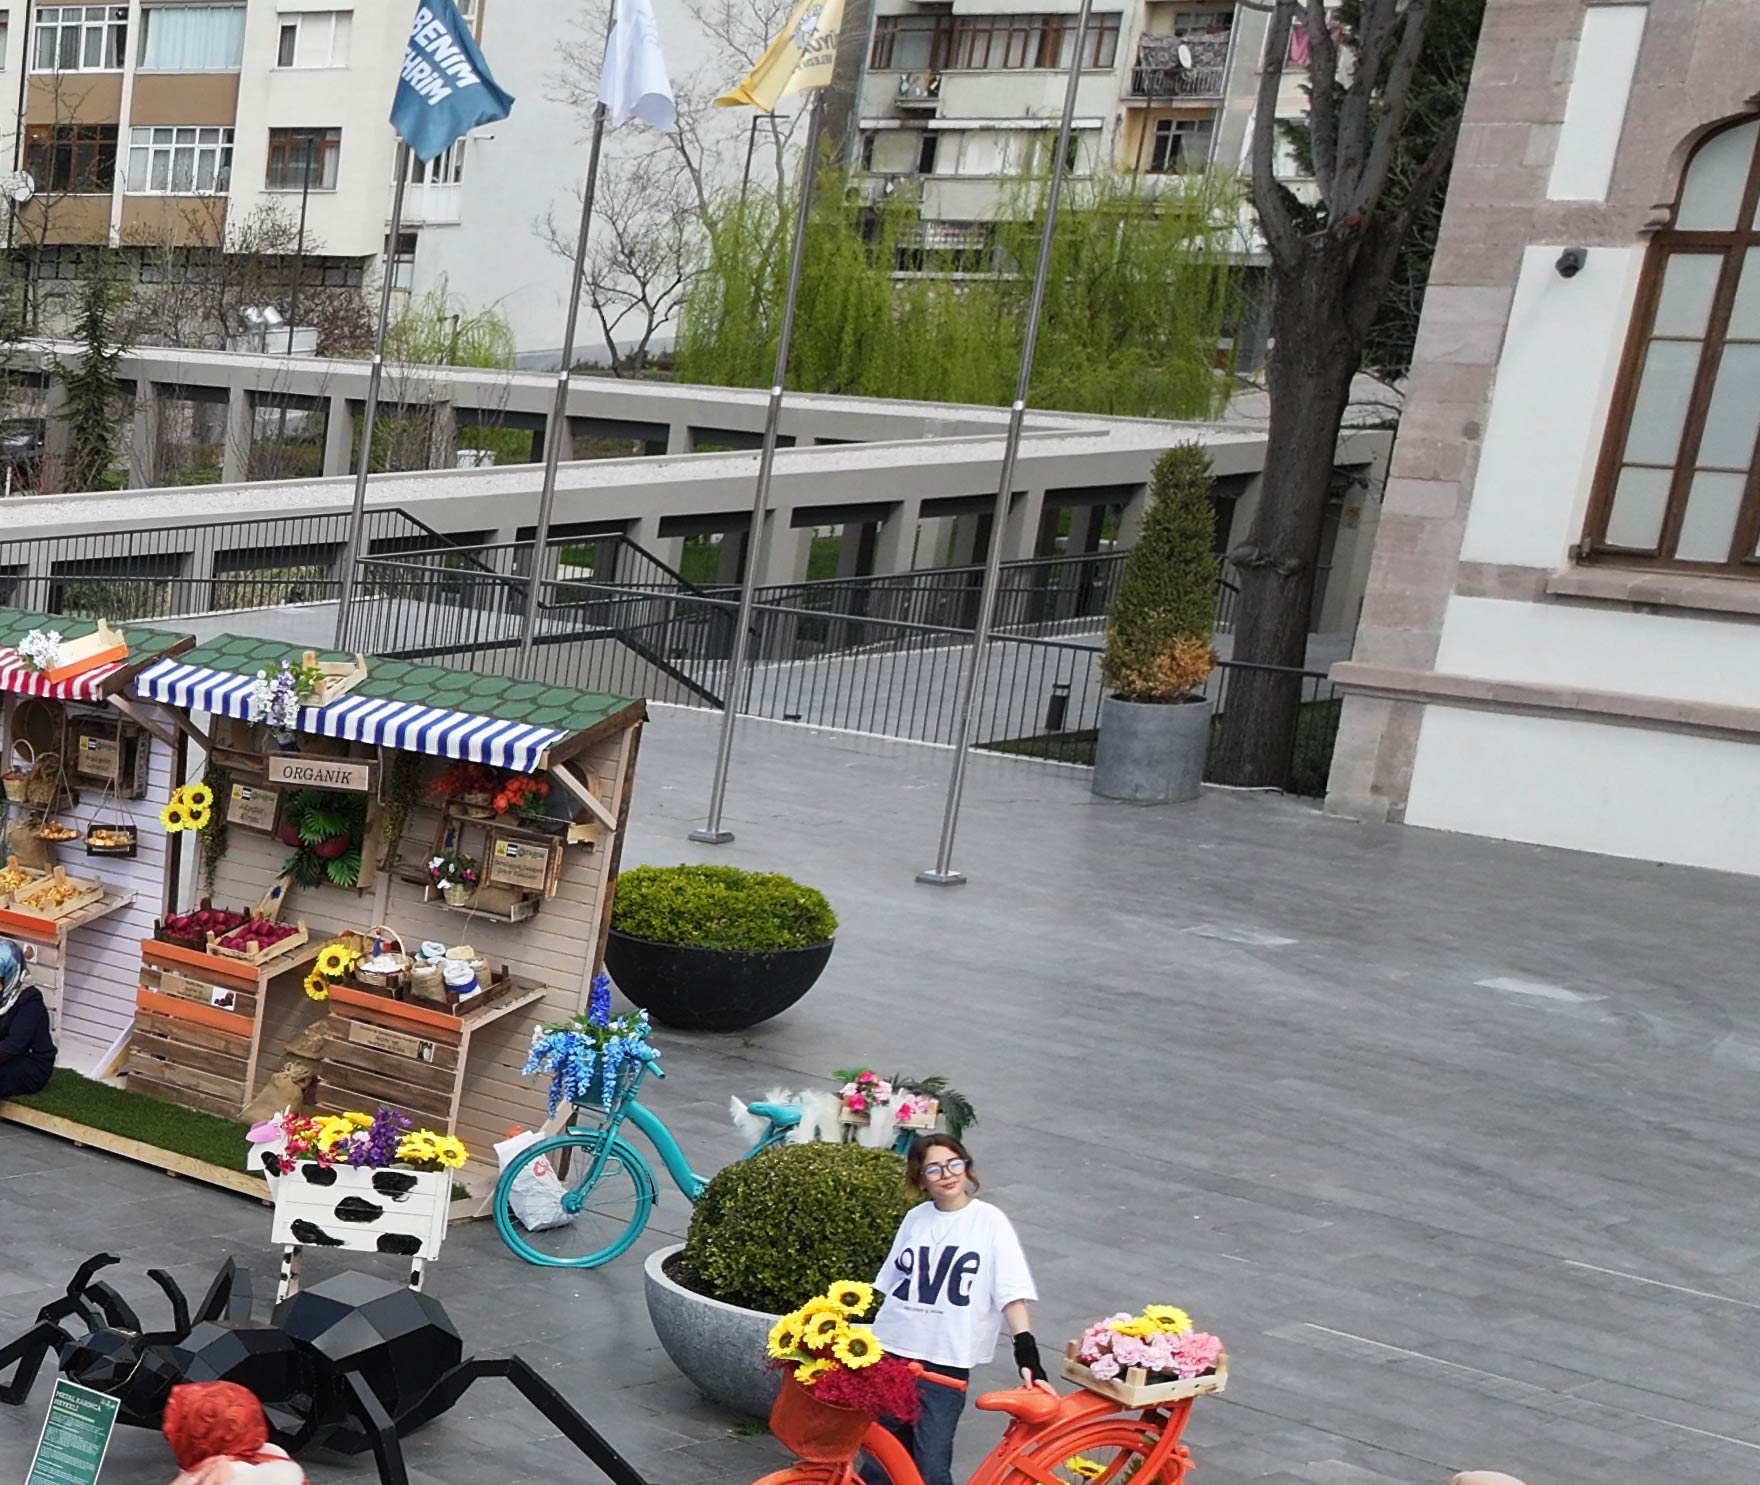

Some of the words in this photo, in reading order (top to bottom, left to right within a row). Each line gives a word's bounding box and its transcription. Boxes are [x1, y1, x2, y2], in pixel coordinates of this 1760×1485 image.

[400, 46, 453, 105] HRİM
[410, 6, 481, 88] BENİM
[282, 765, 353, 785] ORGANİK
